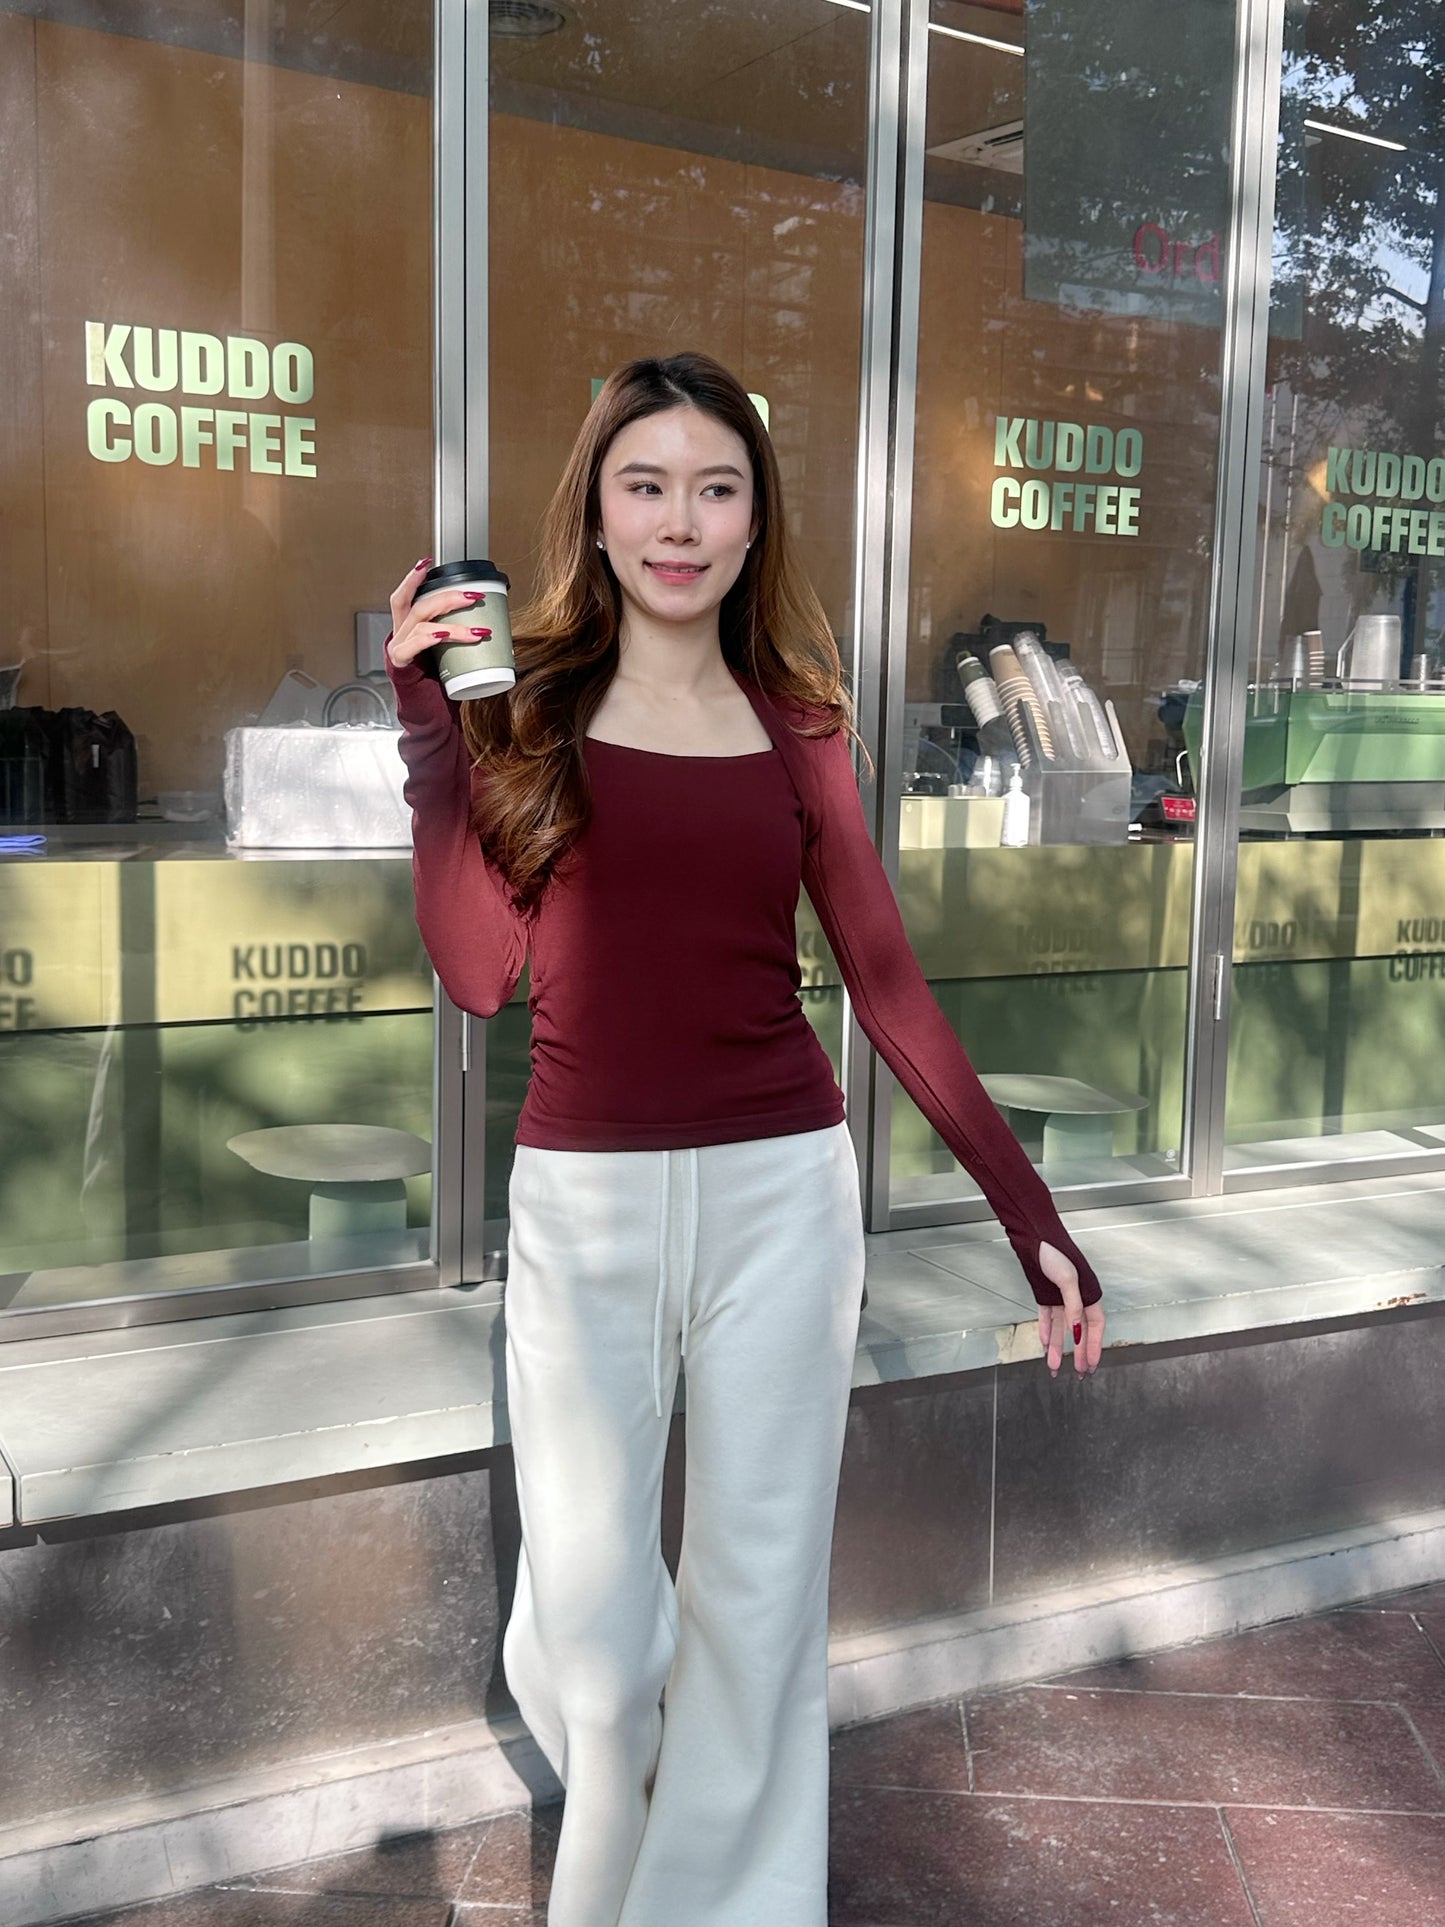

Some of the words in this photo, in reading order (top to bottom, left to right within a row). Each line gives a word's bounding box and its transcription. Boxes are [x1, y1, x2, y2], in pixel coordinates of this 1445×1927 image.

[1133, 223, 1221, 283] Ord
[85, 320, 314, 404] KUDDO
[87, 398, 317, 478] COFFEE
[993, 416, 1143, 478] KUDDO
[1326, 446, 1445, 504] KUDDO
[989, 477, 1142, 537] COFFEE
[1321, 501, 1445, 557] COFFEE
[1396, 918, 1445, 943] KUD
[232, 943, 367, 980] KUDDO
